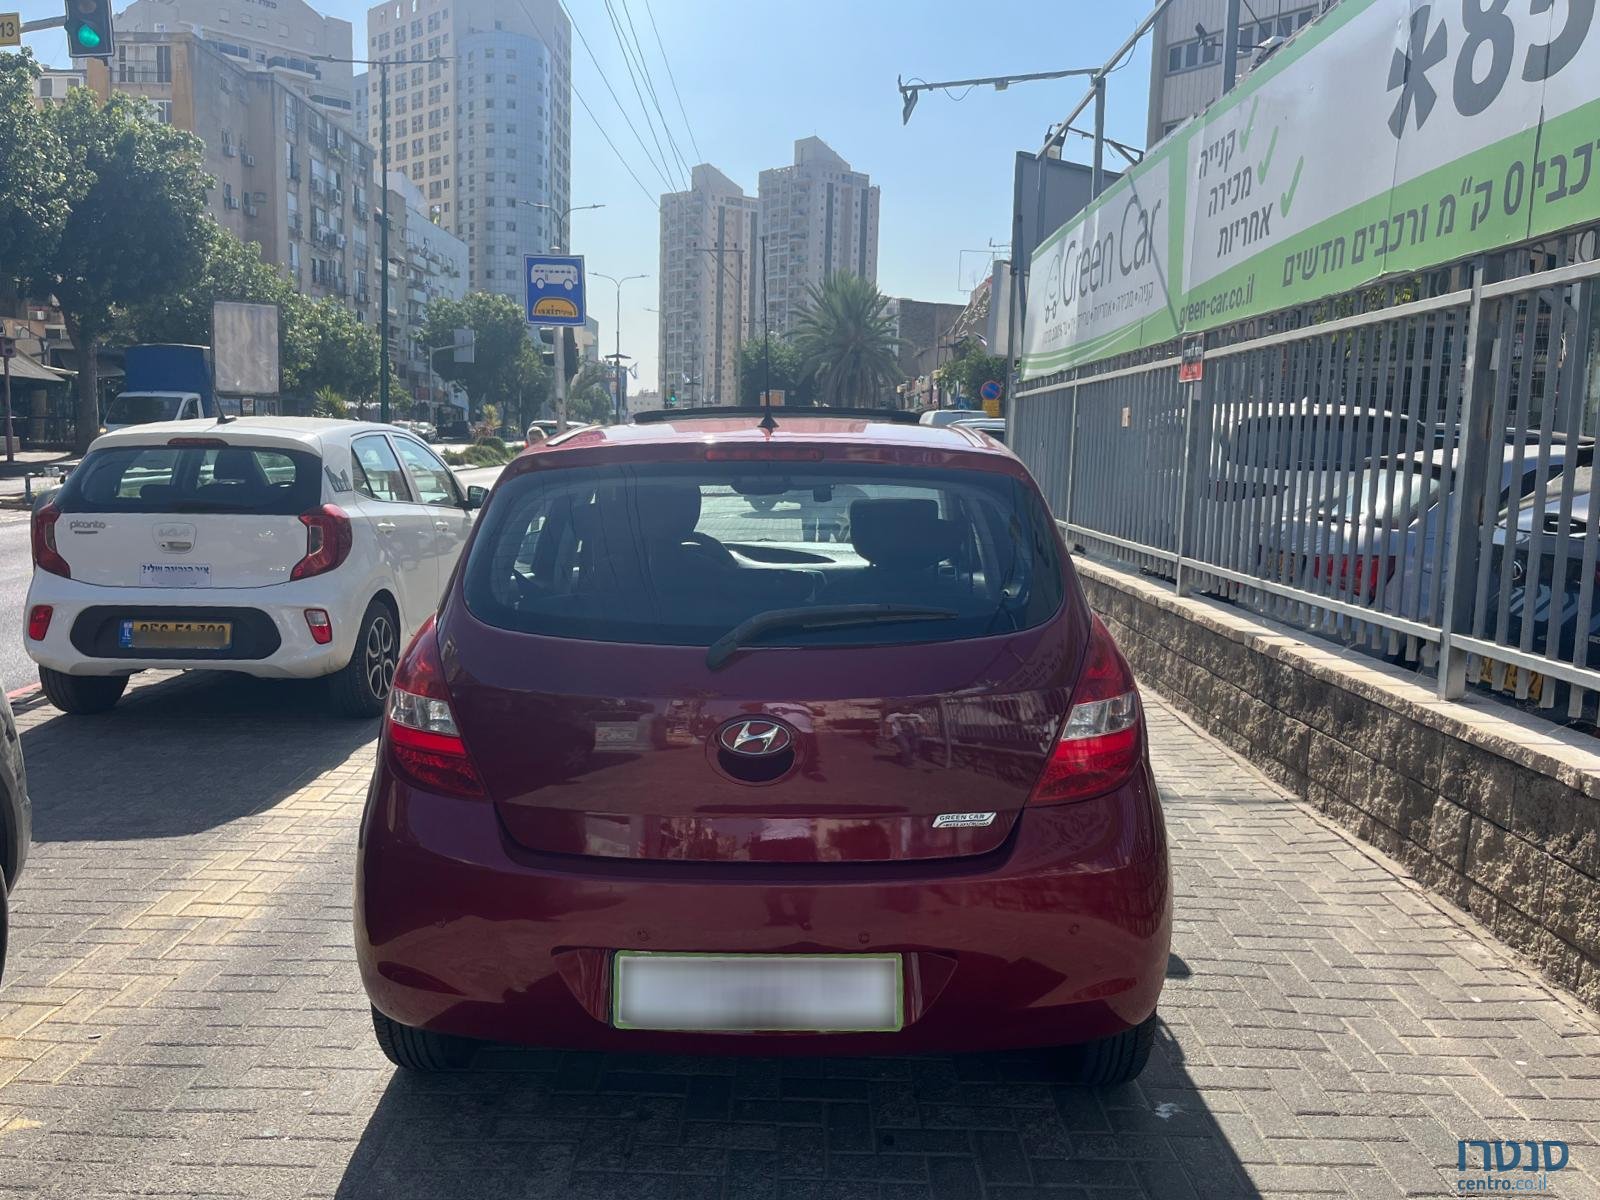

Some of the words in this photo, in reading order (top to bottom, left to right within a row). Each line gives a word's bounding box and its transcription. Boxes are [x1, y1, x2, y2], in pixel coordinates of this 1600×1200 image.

[1199, 129, 1236, 179] קנייה
[1208, 166, 1252, 217] מכירה
[1504, 160, 1524, 216] 0
[1062, 231, 1114, 306] Green
[1119, 194, 1162, 276] Car
[1217, 202, 1274, 258] אחריות
[1351, 203, 1429, 264] ורכבים
[1282, 238, 1345, 287] חדשים
[1178, 273, 1256, 330] green-car.co.il
